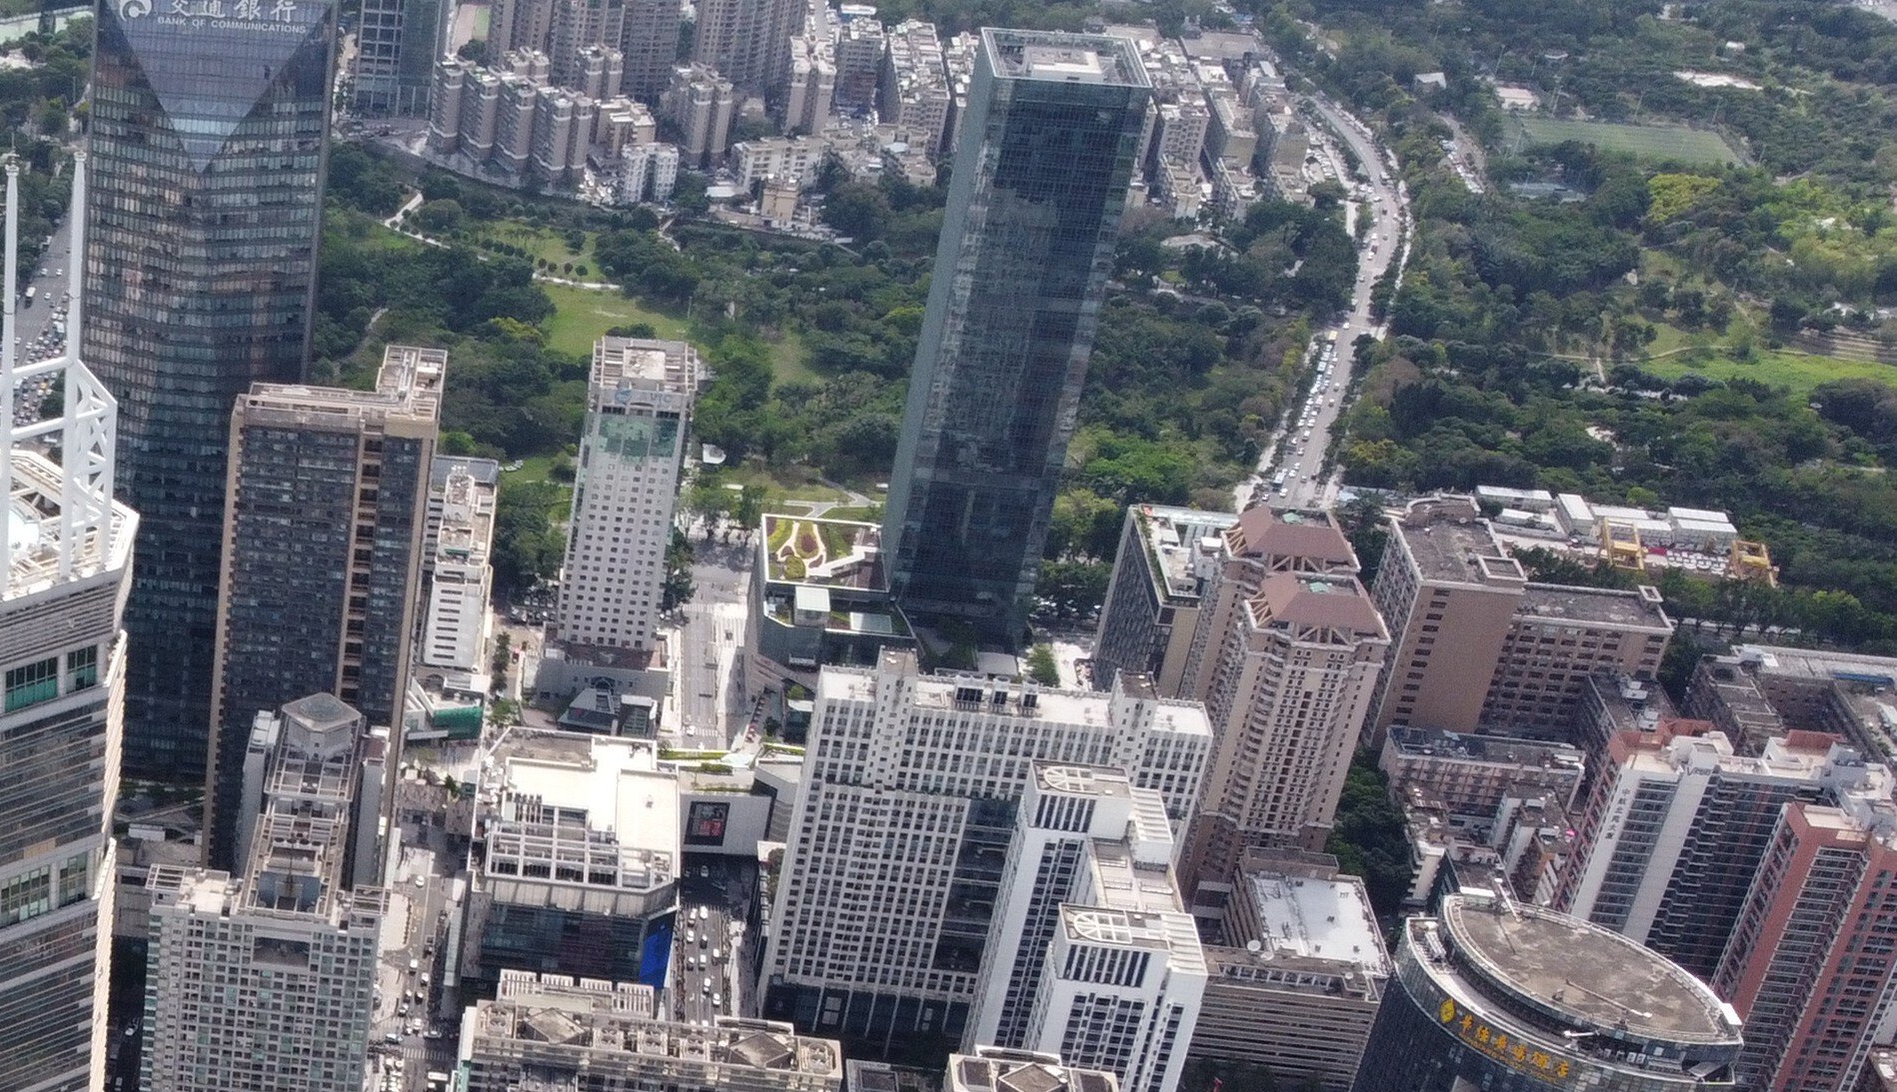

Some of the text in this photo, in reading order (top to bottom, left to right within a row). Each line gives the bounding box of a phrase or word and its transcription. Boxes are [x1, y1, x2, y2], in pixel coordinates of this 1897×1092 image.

[157, 16, 307, 35] BANK OF COMMUNICATIONS
